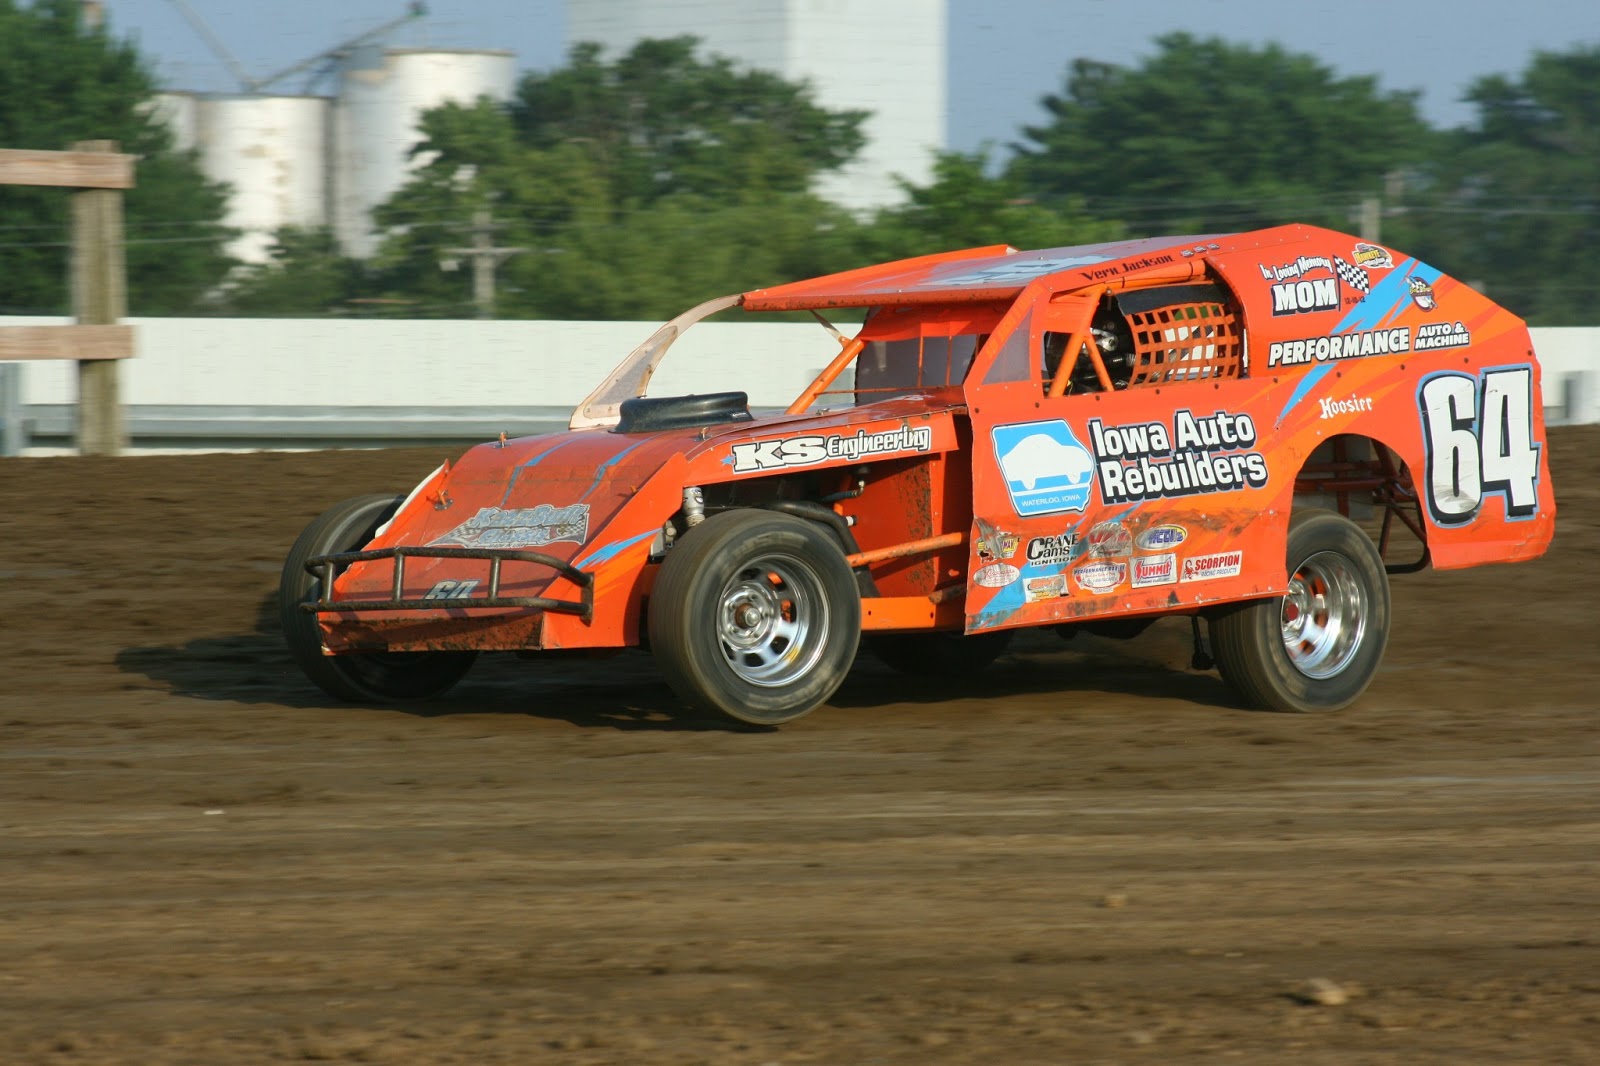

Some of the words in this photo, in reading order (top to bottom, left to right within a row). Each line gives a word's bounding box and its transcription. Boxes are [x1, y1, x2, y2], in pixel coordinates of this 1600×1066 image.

[1080, 268, 1119, 281] Vern
[1123, 255, 1175, 273] Jackson
[1259, 263, 1274, 280] In
[1273, 261, 1299, 282] Loving
[1298, 256, 1334, 275] Memory
[1272, 278, 1338, 315] MOM
[1415, 332, 1470, 350] MACHINE
[1418, 324, 1451, 338] AUTO
[1453, 322, 1466, 334] &
[1268, 328, 1410, 367] PERFORMANCE
[1319, 393, 1373, 420] Hoosier
[1090, 419, 1170, 459] Iowa
[1174, 410, 1255, 452] Auto
[1418, 365, 1540, 527] 64
[733, 437, 827, 472] KS
[826, 425, 931, 460] Engineering
[1100, 453, 1268, 503] Rebuilders
[1021, 496, 1061, 508] WATERLOO,
[1061, 493, 1081, 503] IOWA
[1027, 534, 1080, 557] CRANE
[1031, 556, 1078, 567] IGNITION
[1195, 554, 1240, 571] SCORPION
